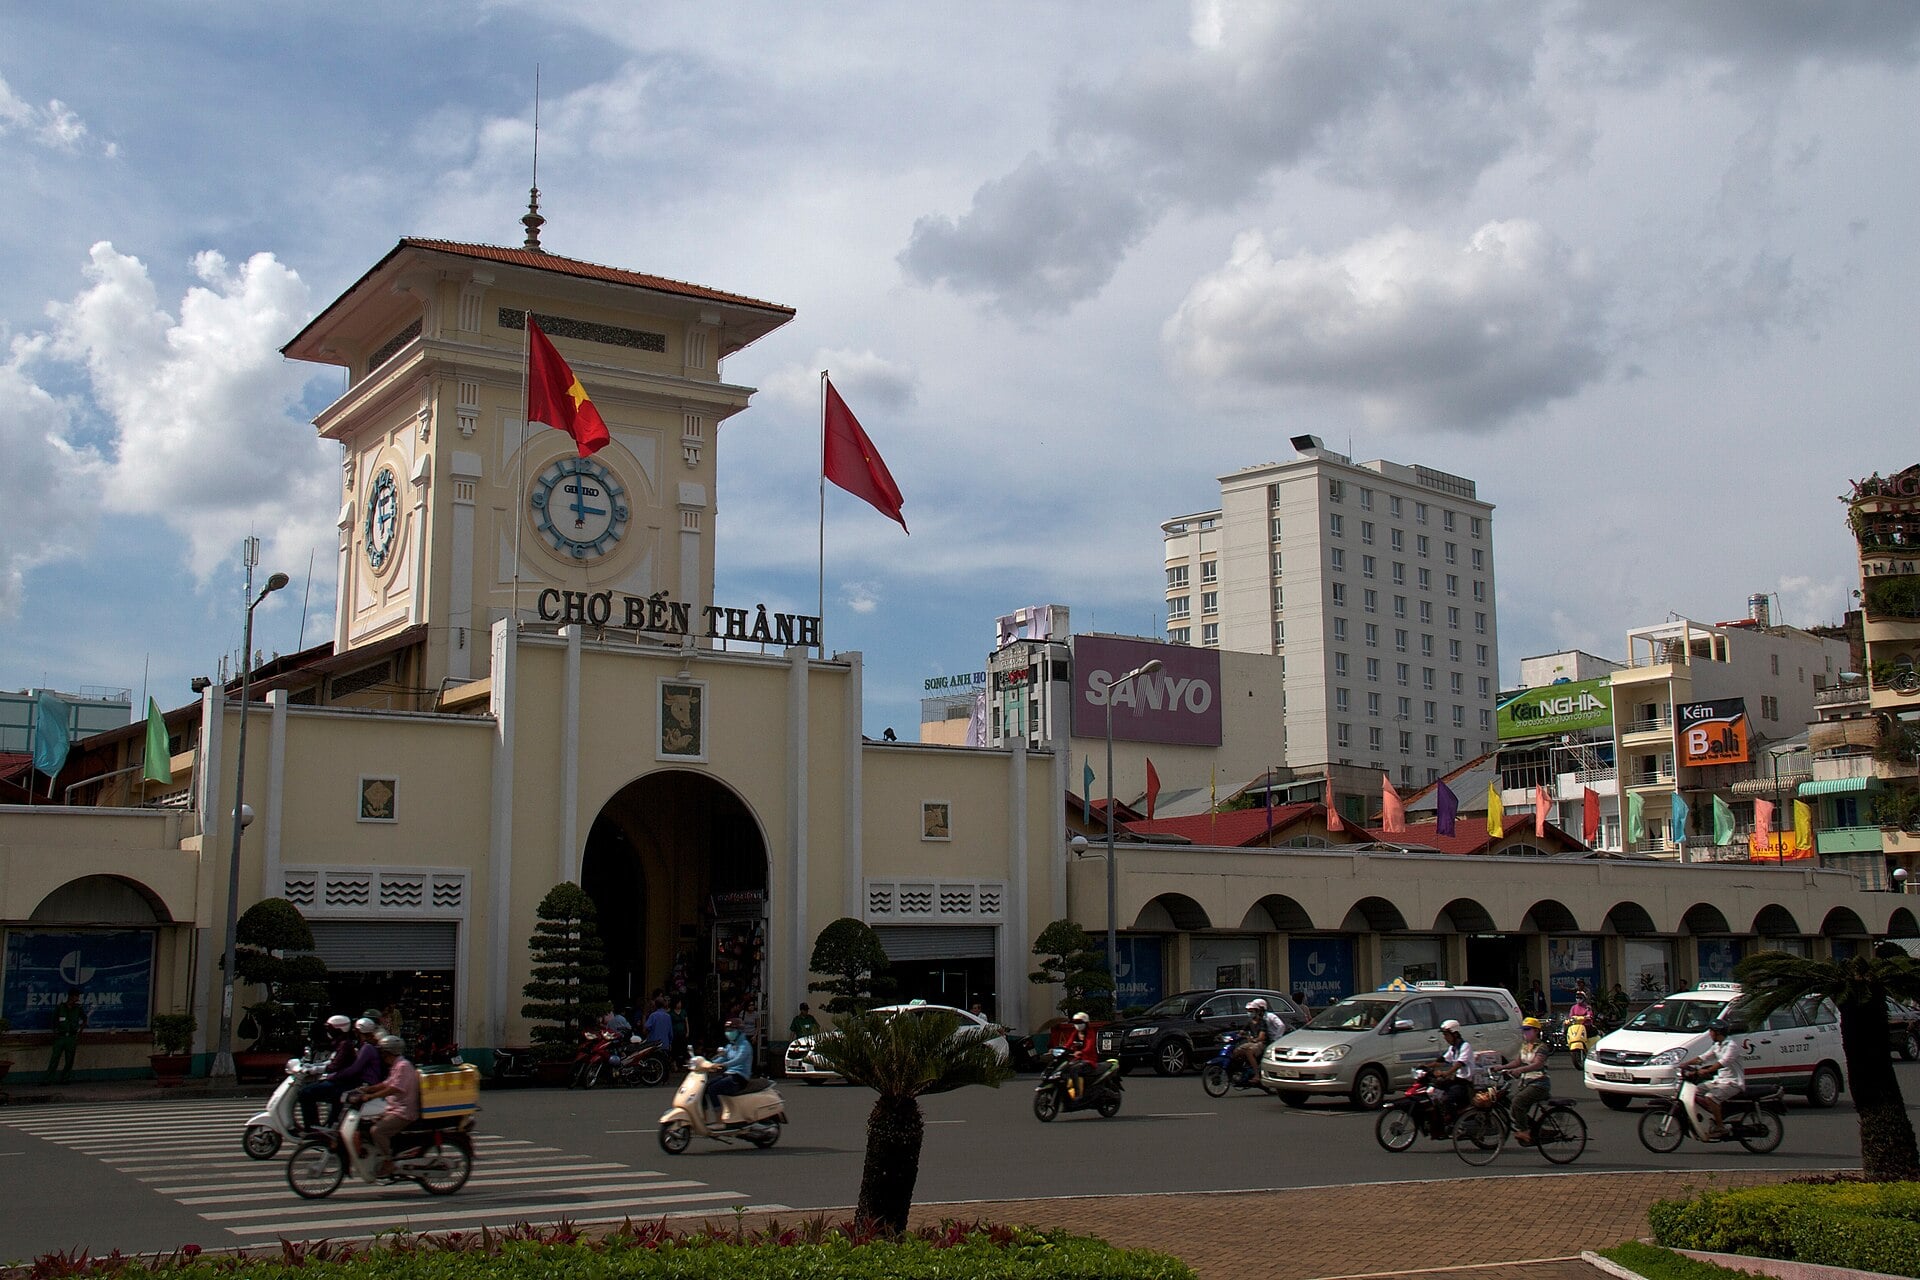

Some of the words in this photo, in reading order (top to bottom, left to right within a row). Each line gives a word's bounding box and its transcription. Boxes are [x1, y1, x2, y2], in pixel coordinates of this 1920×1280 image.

[537, 588, 612, 628] CHỢ
[623, 590, 691, 635] BẾN
[702, 603, 821, 646] THÀNH
[924, 677, 948, 690] SONG
[950, 674, 971, 687] ANH
[1085, 669, 1212, 717] SANYO
[1539, 690, 1608, 717] NGHĨA
[1683, 704, 1713, 720] Kềm
[1688, 727, 1739, 755] Balli
[1116, 982, 1149, 993] BANK
[1292, 980, 1341, 991] EXIMBANK
[1552, 976, 1592, 985] EXIMBK
